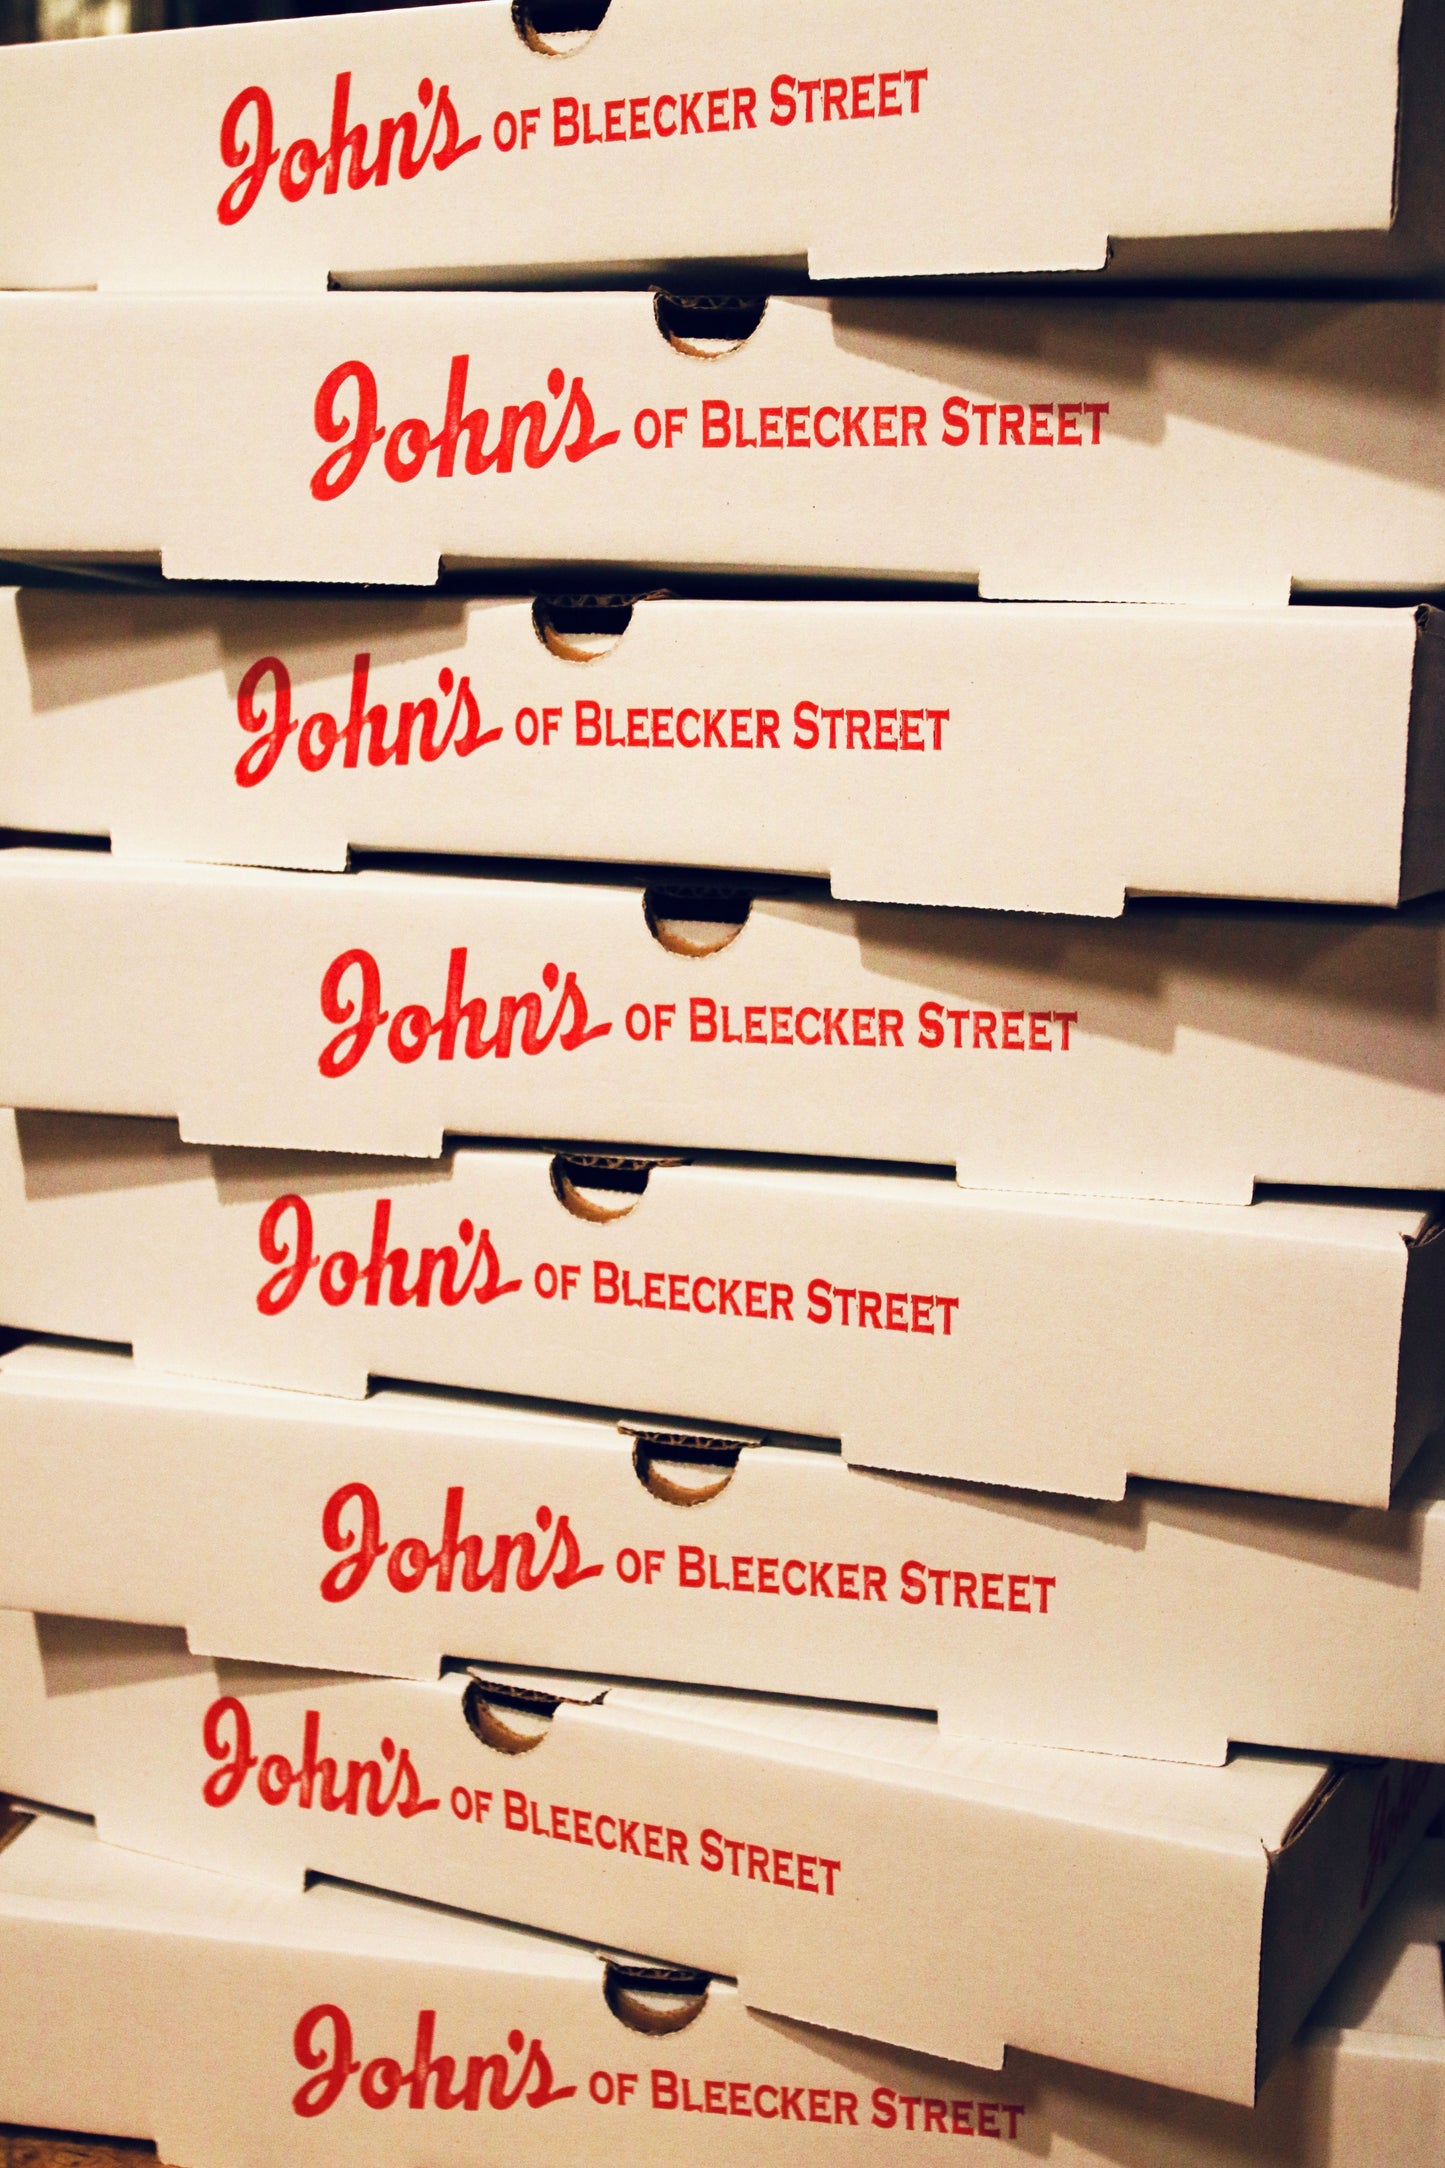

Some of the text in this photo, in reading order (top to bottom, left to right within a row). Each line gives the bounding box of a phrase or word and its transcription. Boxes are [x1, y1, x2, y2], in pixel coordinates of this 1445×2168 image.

[216, 67, 929, 226] John's OF BLEECKER STREET
[309, 353, 1111, 502] John's OF BLEECKER STREET
[234, 651, 950, 789] John's OF BLEECKER STREET
[317, 946, 1079, 1079] John's OF BLEECKER STREET
[255, 1192, 960, 1336] John's OF BLEECKER STREET
[319, 1481, 1057, 1614] John's OF BLEECKER STREET
[202, 1694, 842, 1896] John's OF BLEECKER STREET
[291, 2002, 1025, 2140] John's OF BLEECKER STREET
